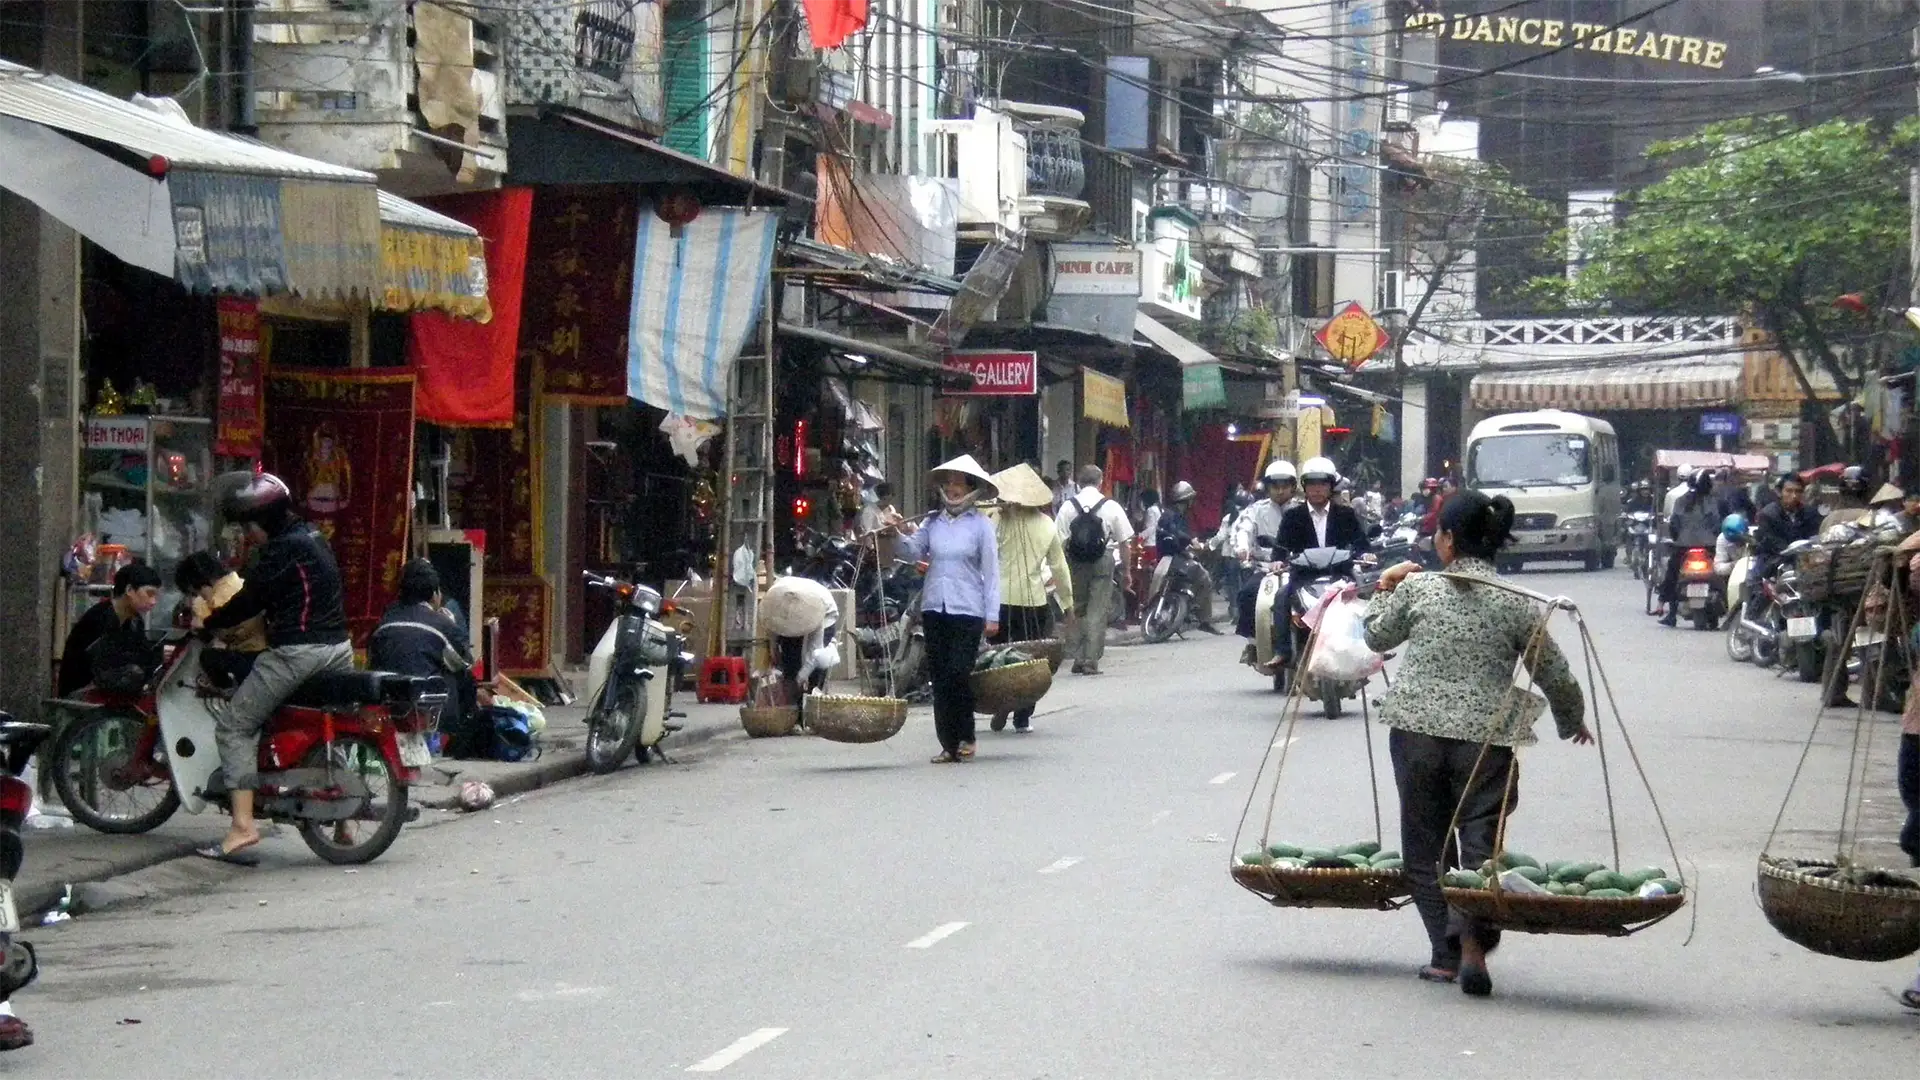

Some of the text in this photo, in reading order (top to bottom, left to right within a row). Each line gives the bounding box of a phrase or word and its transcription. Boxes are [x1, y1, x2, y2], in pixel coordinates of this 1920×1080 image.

[1451, 13, 1564, 47] DANCE
[1571, 22, 1728, 69] THEATRE
[1095, 260, 1133, 275] CAFE
[975, 361, 1031, 386] GALLERY
